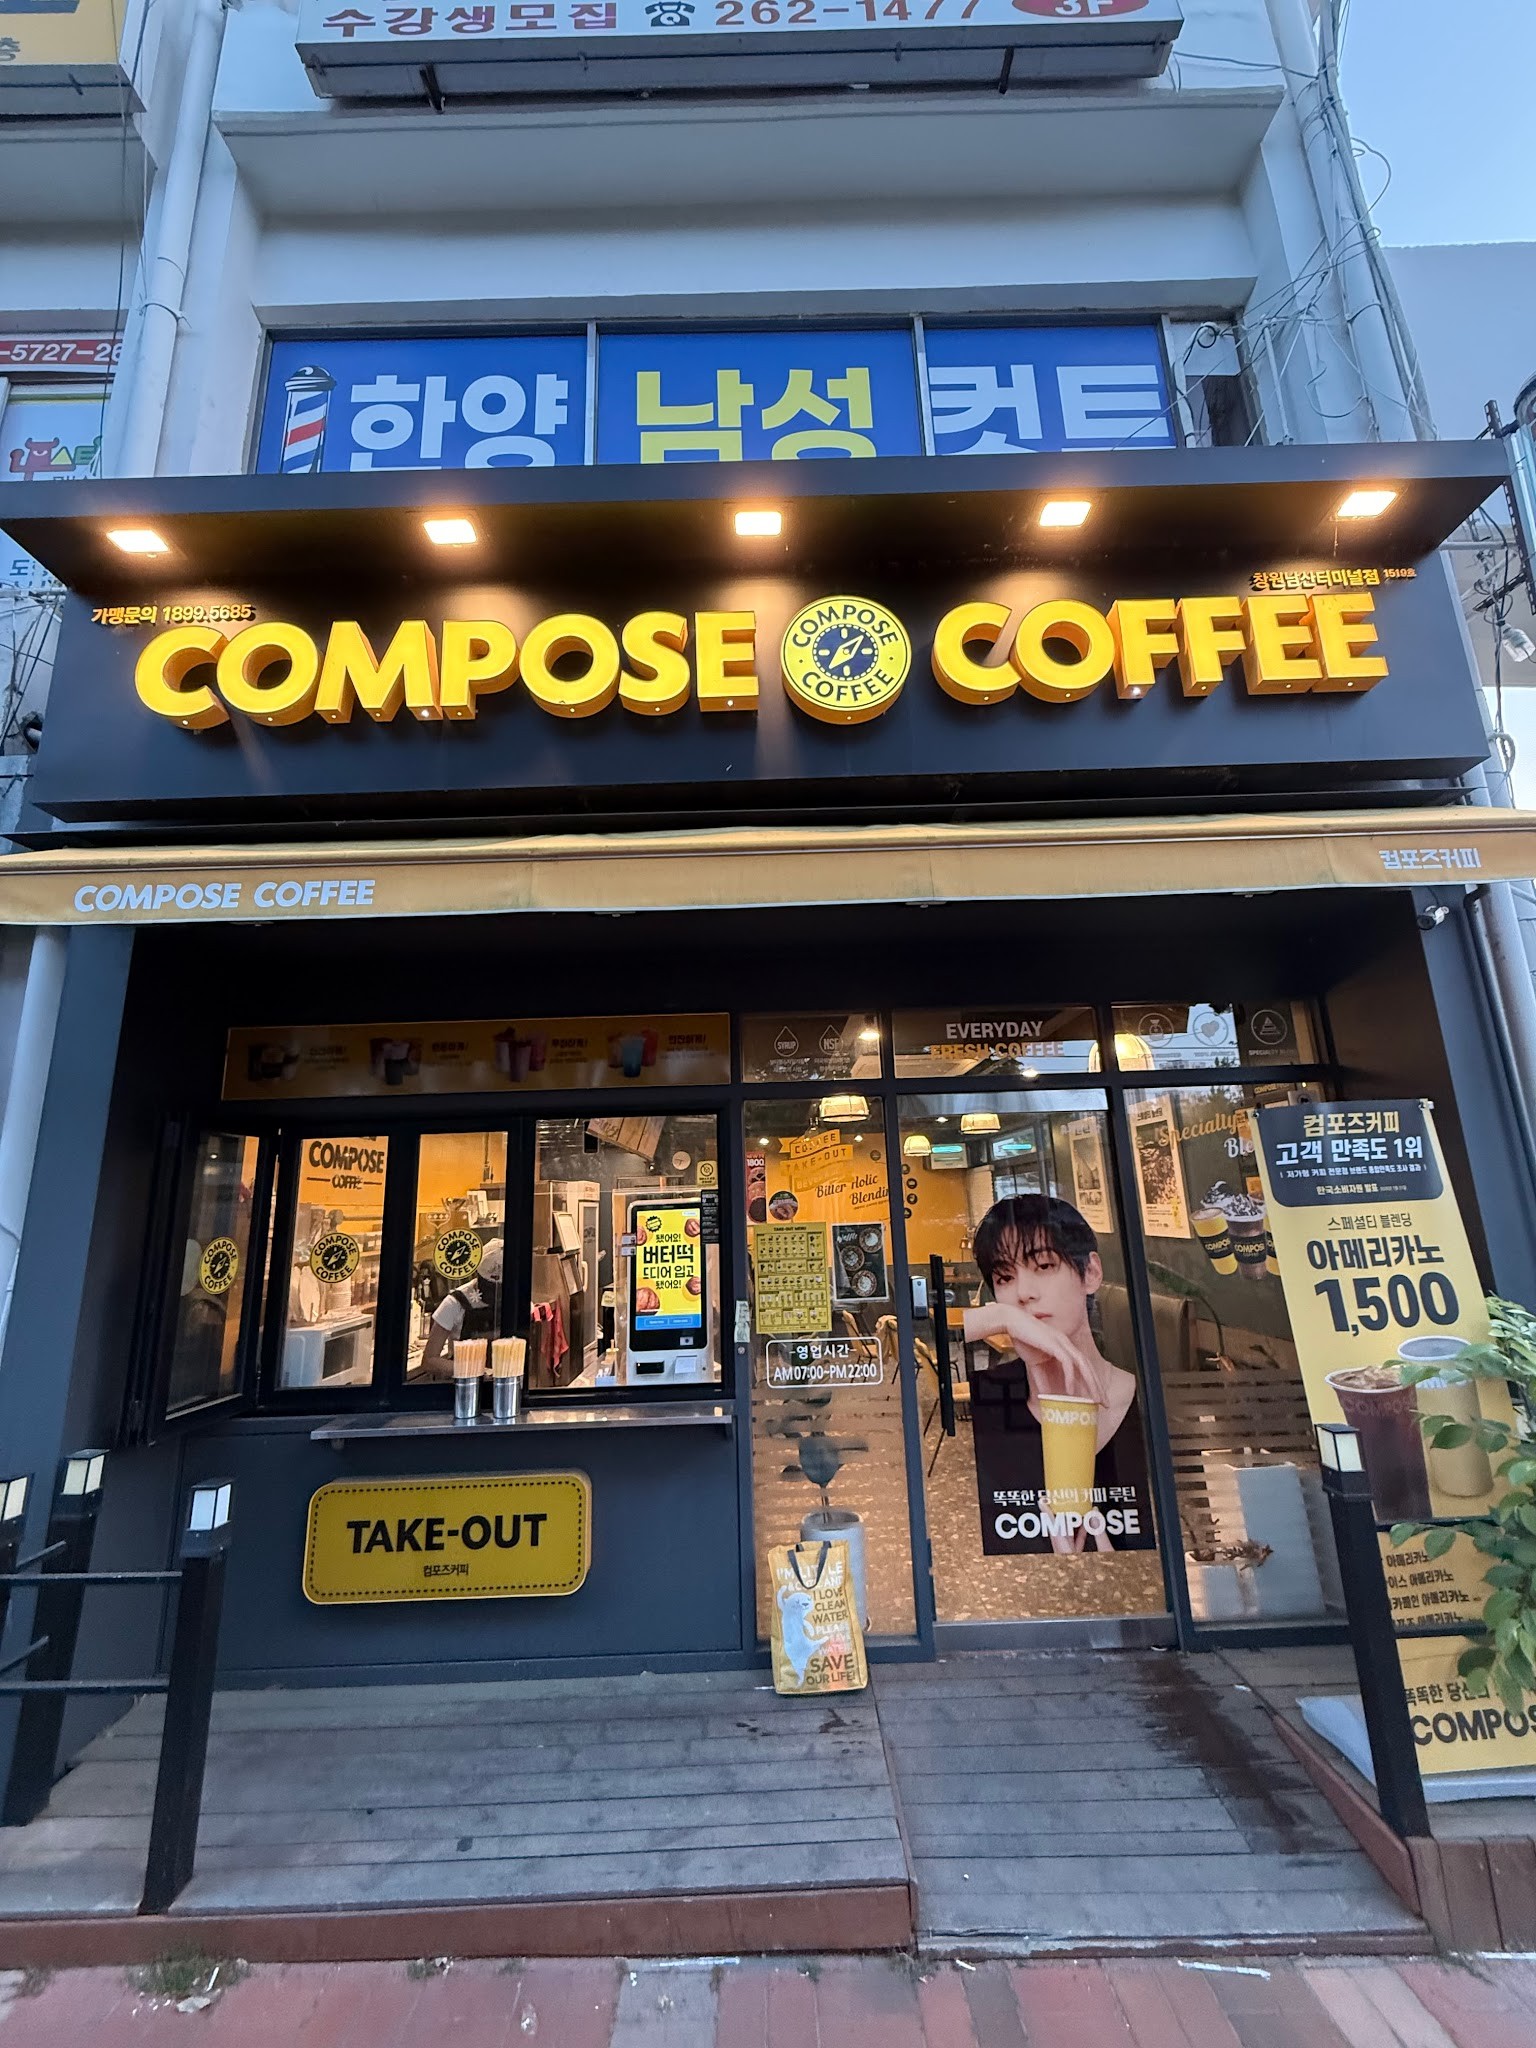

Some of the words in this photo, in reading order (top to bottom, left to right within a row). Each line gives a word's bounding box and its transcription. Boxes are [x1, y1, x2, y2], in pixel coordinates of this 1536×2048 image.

[323, 2, 617, 38] 수강생모집
[350, 373, 569, 471] 한양
[636, 367, 877, 464] 남성
[1253, 569, 1381, 589] 창원남산터미널점
[91, 606, 158, 625] 가맹문의
[163, 604, 252, 622] 1899.5685
[792, 604, 899, 648] COMPOSE
[135, 611, 759, 724] COMPOSE
[931, 593, 1389, 702] COFFEE
[802, 669, 895, 702] COFFEE
[1379, 848, 1481, 870] 컴포즈커피
[74, 883, 242, 912] COMPOSE
[254, 880, 376, 908] COFFEE
[946, 1021, 1042, 1039] EVERYDAY
[930, 1043, 989, 1059] FRESH
[995, 1041, 1065, 1059] COFFEE
[1303, 1111, 1400, 1137] 컴포즈커피
[309, 1141, 385, 1173] COMPOSE
[1275, 1141, 1323, 1165] 고객
[1331, 1137, 1389, 1162] 만족도
[1394, 1136, 1423, 1159] 1위
[1311, 1168, 1327, 1177] 커피
[1316, 1184, 1364, 1195] 한국소비자원
[1327, 1214, 1378, 1231] 스페셜티
[1380, 1213, 1412, 1228] 블렌딩
[314, 1235, 357, 1256] COMPOSE
[437, 1230, 480, 1252] COMPOSE
[204, 1240, 237, 1265] COMPOSE
[643, 1243, 693, 1264] 버터떡
[1307, 1235, 1445, 1271] 아메리카노
[315, 1266, 353, 1280] COFFEE
[439, 1260, 476, 1276] COFFEE
[643, 1265, 671, 1279] 드디어
[674, 1265, 694, 1278] 입고
[204, 1274, 233, 1290] COFFEE
[1314, 1272, 1460, 1337] 1,500
[993, 1489, 1035, 1506] 똑똑한
[1108, 1486, 1137, 1503] 루틴
[347, 1513, 548, 1554] TAKE-OUT
[995, 1509, 1141, 1539] COMPOSE
[423, 1563, 470, 1577] 컴포즈커피
[1409, 1569, 1454, 1586] 아메리카노
[815, 1599, 846, 1612] CLEAN
[1390, 1595, 1420, 1610] 카페인
[1421, 1590, 1470, 1606] 아메리카노
[812, 1610, 848, 1625] WATER
[810, 1653, 855, 1673] SAVE
[806, 1674, 830, 1685] OUR
[831, 1671, 855, 1682] LIFE!
